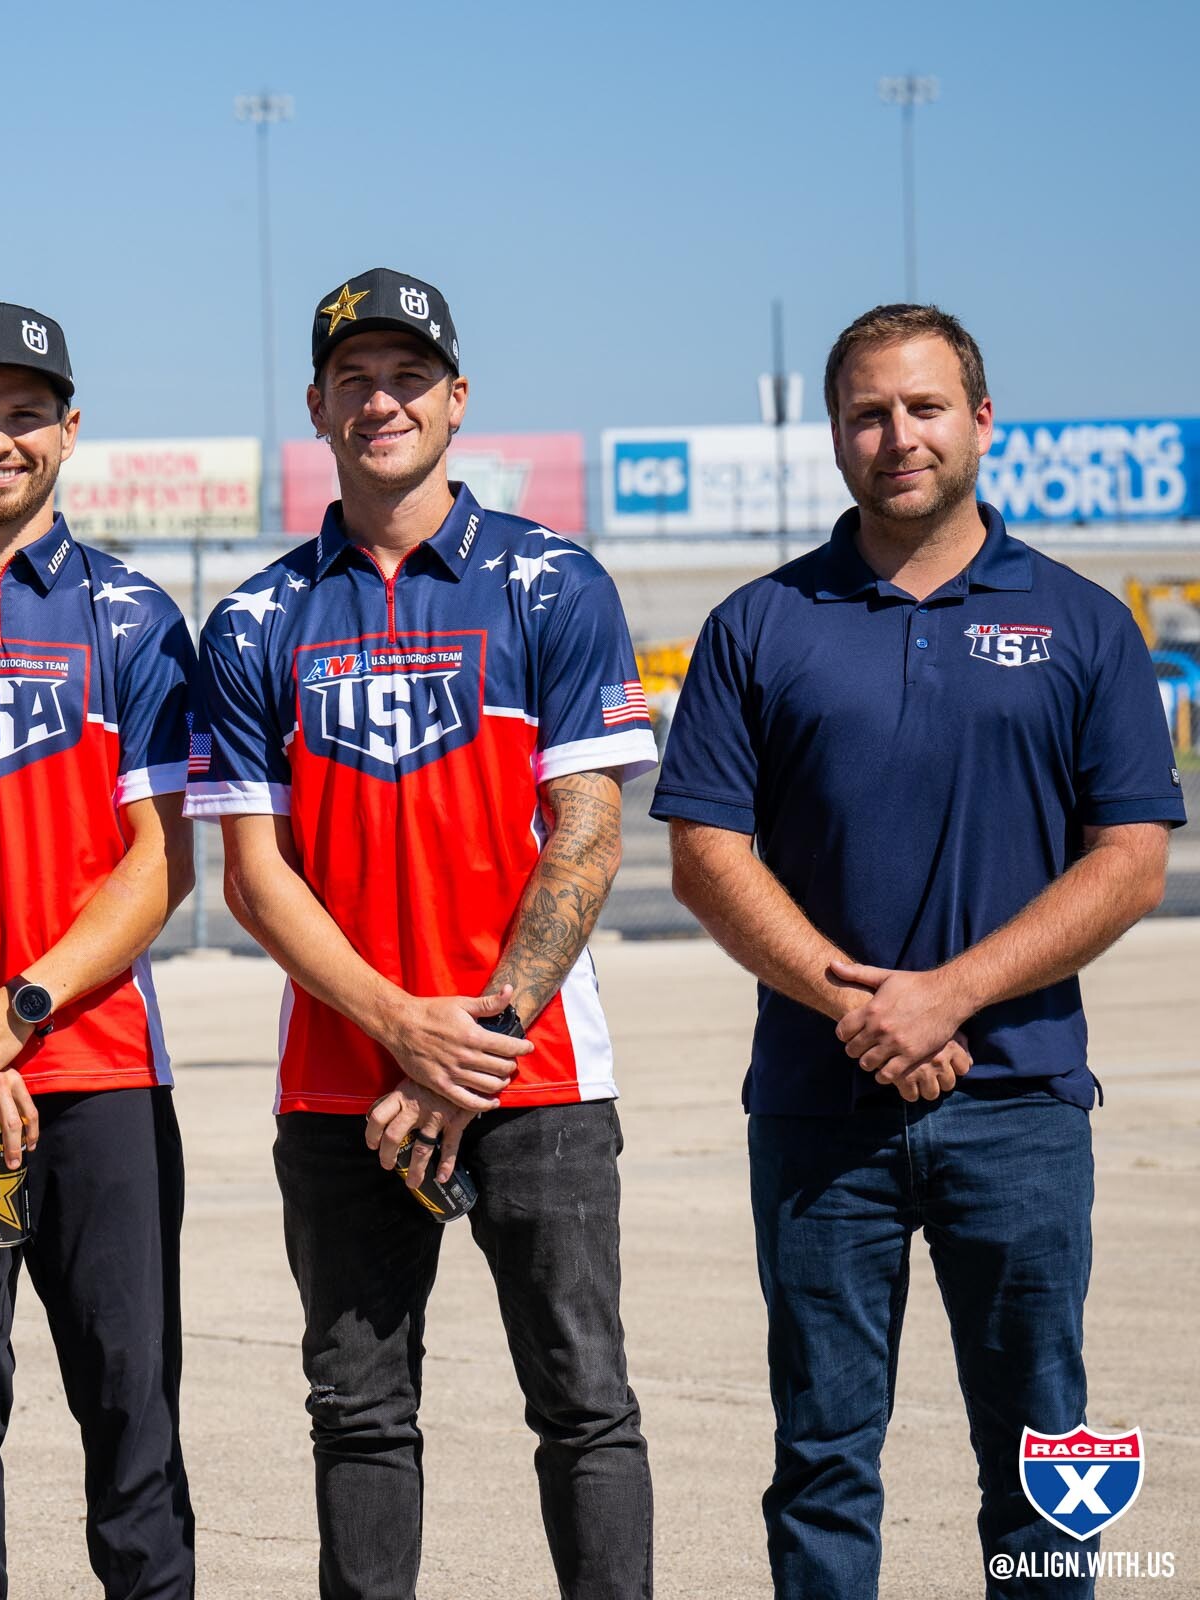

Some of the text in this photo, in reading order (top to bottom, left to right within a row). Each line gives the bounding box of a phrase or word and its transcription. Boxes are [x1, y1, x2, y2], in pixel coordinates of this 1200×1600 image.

[109, 452, 199, 479] UNION
[616, 456, 687, 498] IGS
[68, 481, 250, 512] CARPENTERS
[978, 462, 1188, 516] WORLD
[457, 513, 480, 559] USA
[47, 539, 71, 575] USA
[45, 661, 69, 671] TEAM
[303, 651, 462, 683] AMA U.S. MOTOCROSS TEAM
[964, 633, 1051, 667] USA
[304, 671, 462, 765] USA
